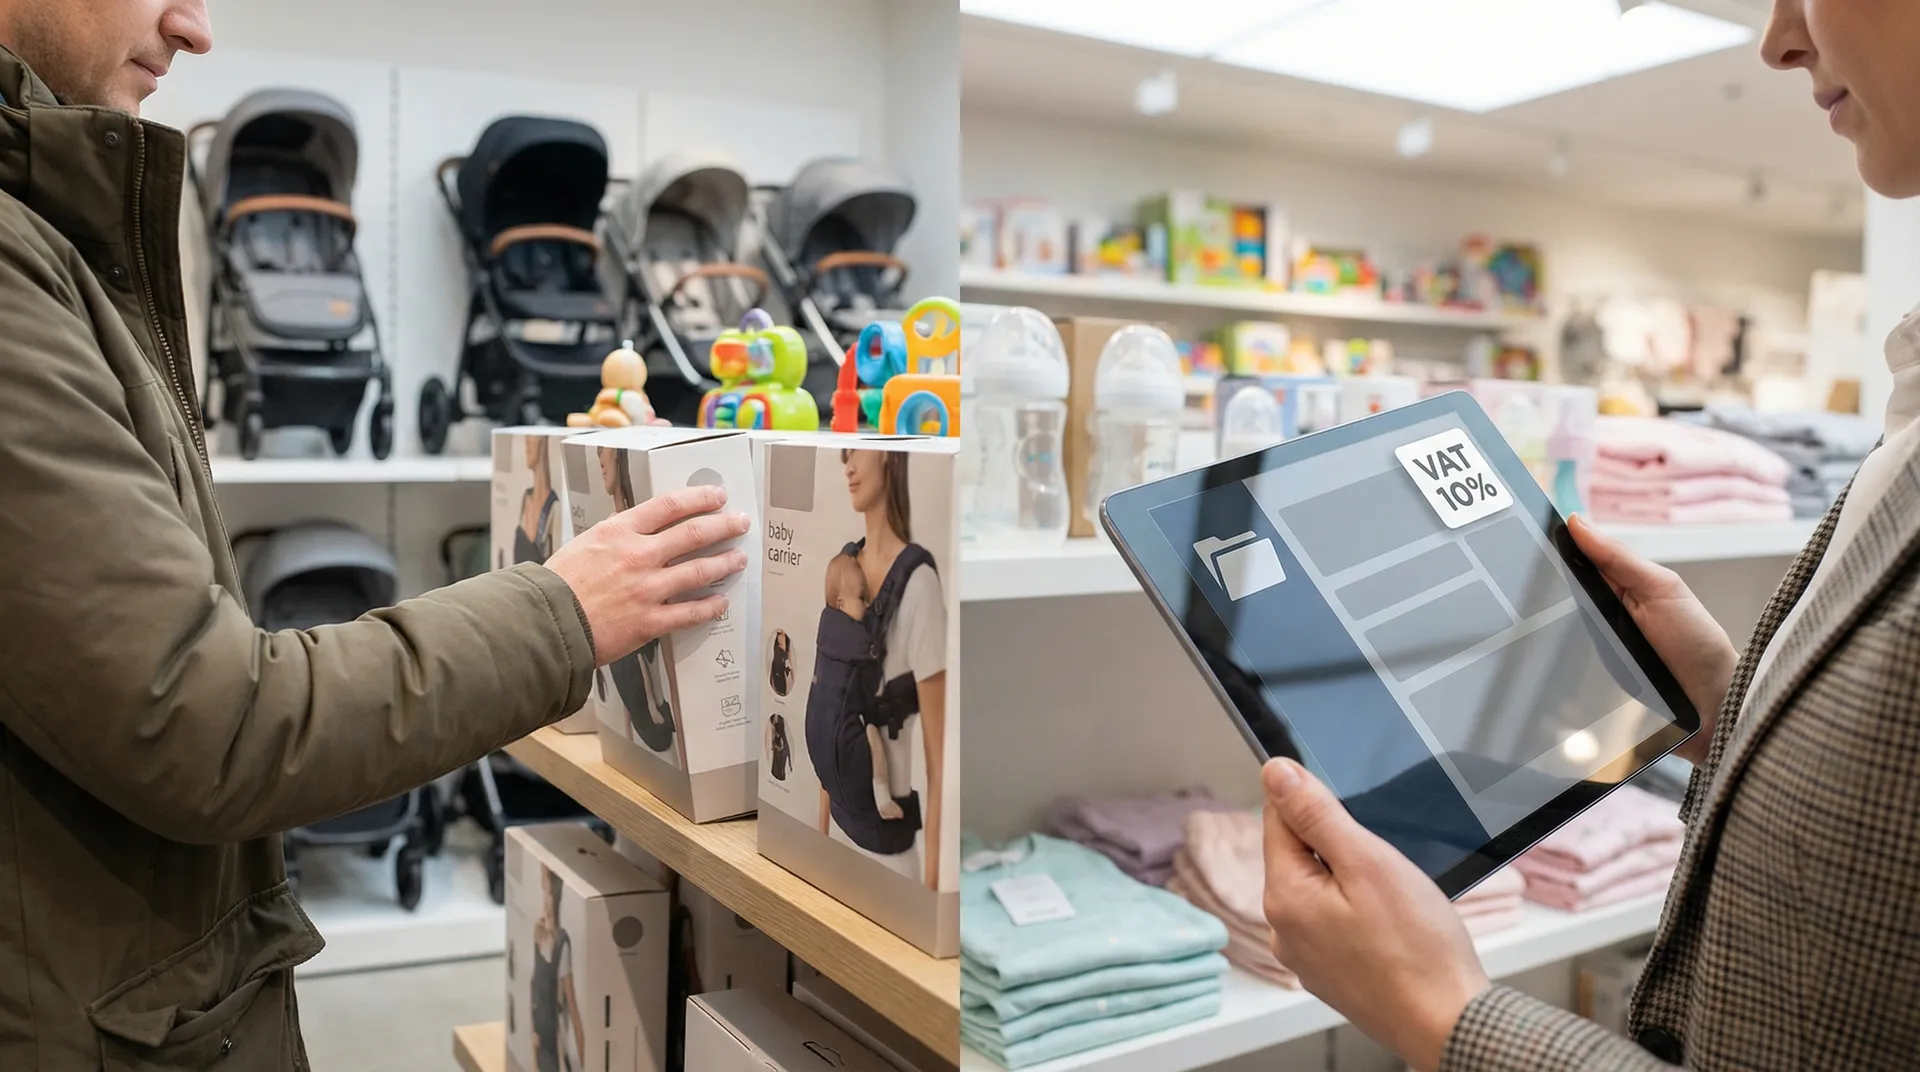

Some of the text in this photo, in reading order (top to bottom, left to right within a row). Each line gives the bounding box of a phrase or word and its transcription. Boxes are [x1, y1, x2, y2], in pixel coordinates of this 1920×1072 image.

[1412, 443, 1471, 481] VAT
[1436, 473, 1498, 511] 10%
[768, 520, 794, 546] baby
[767, 547, 802, 566] carrier
